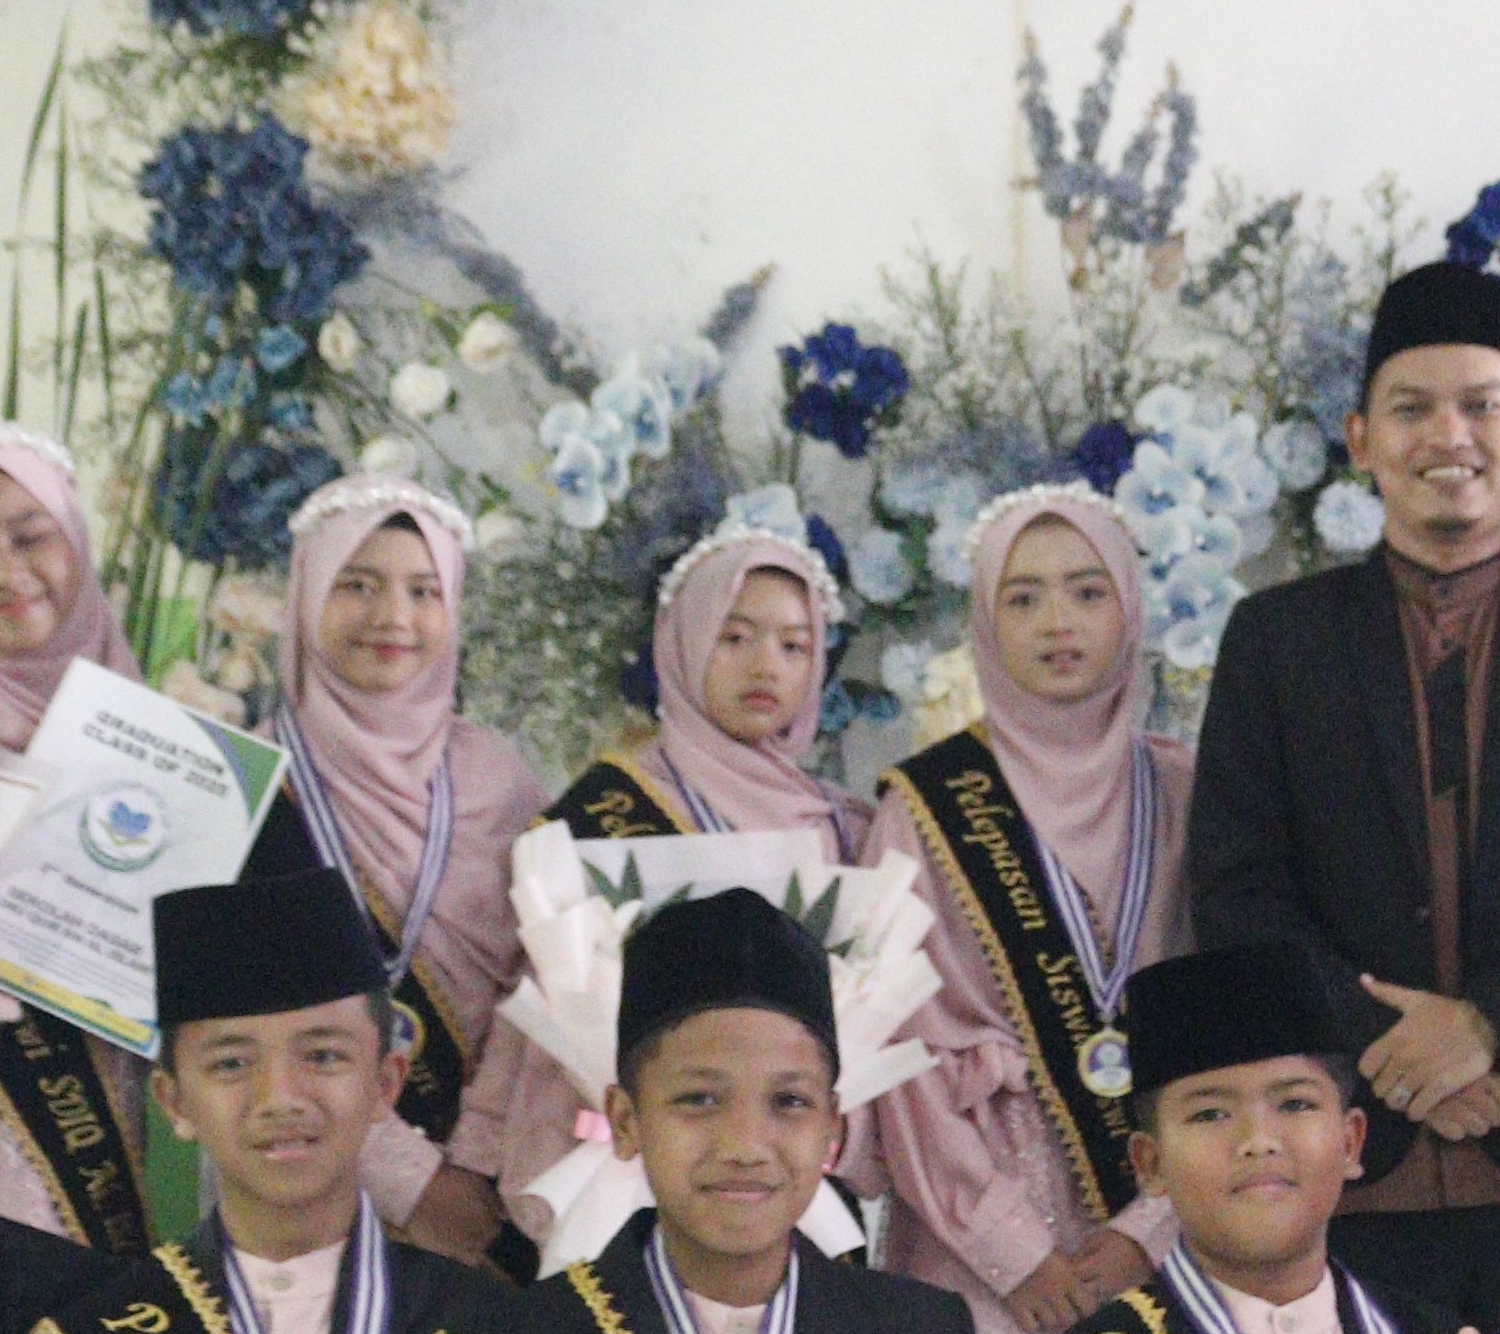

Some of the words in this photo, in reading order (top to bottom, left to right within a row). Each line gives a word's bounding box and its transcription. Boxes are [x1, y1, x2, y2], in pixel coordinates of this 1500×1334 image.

[82, 722, 149, 762] CLASS
[152, 754, 181, 775] OF
[946, 769, 1048, 931] Pelepasan
